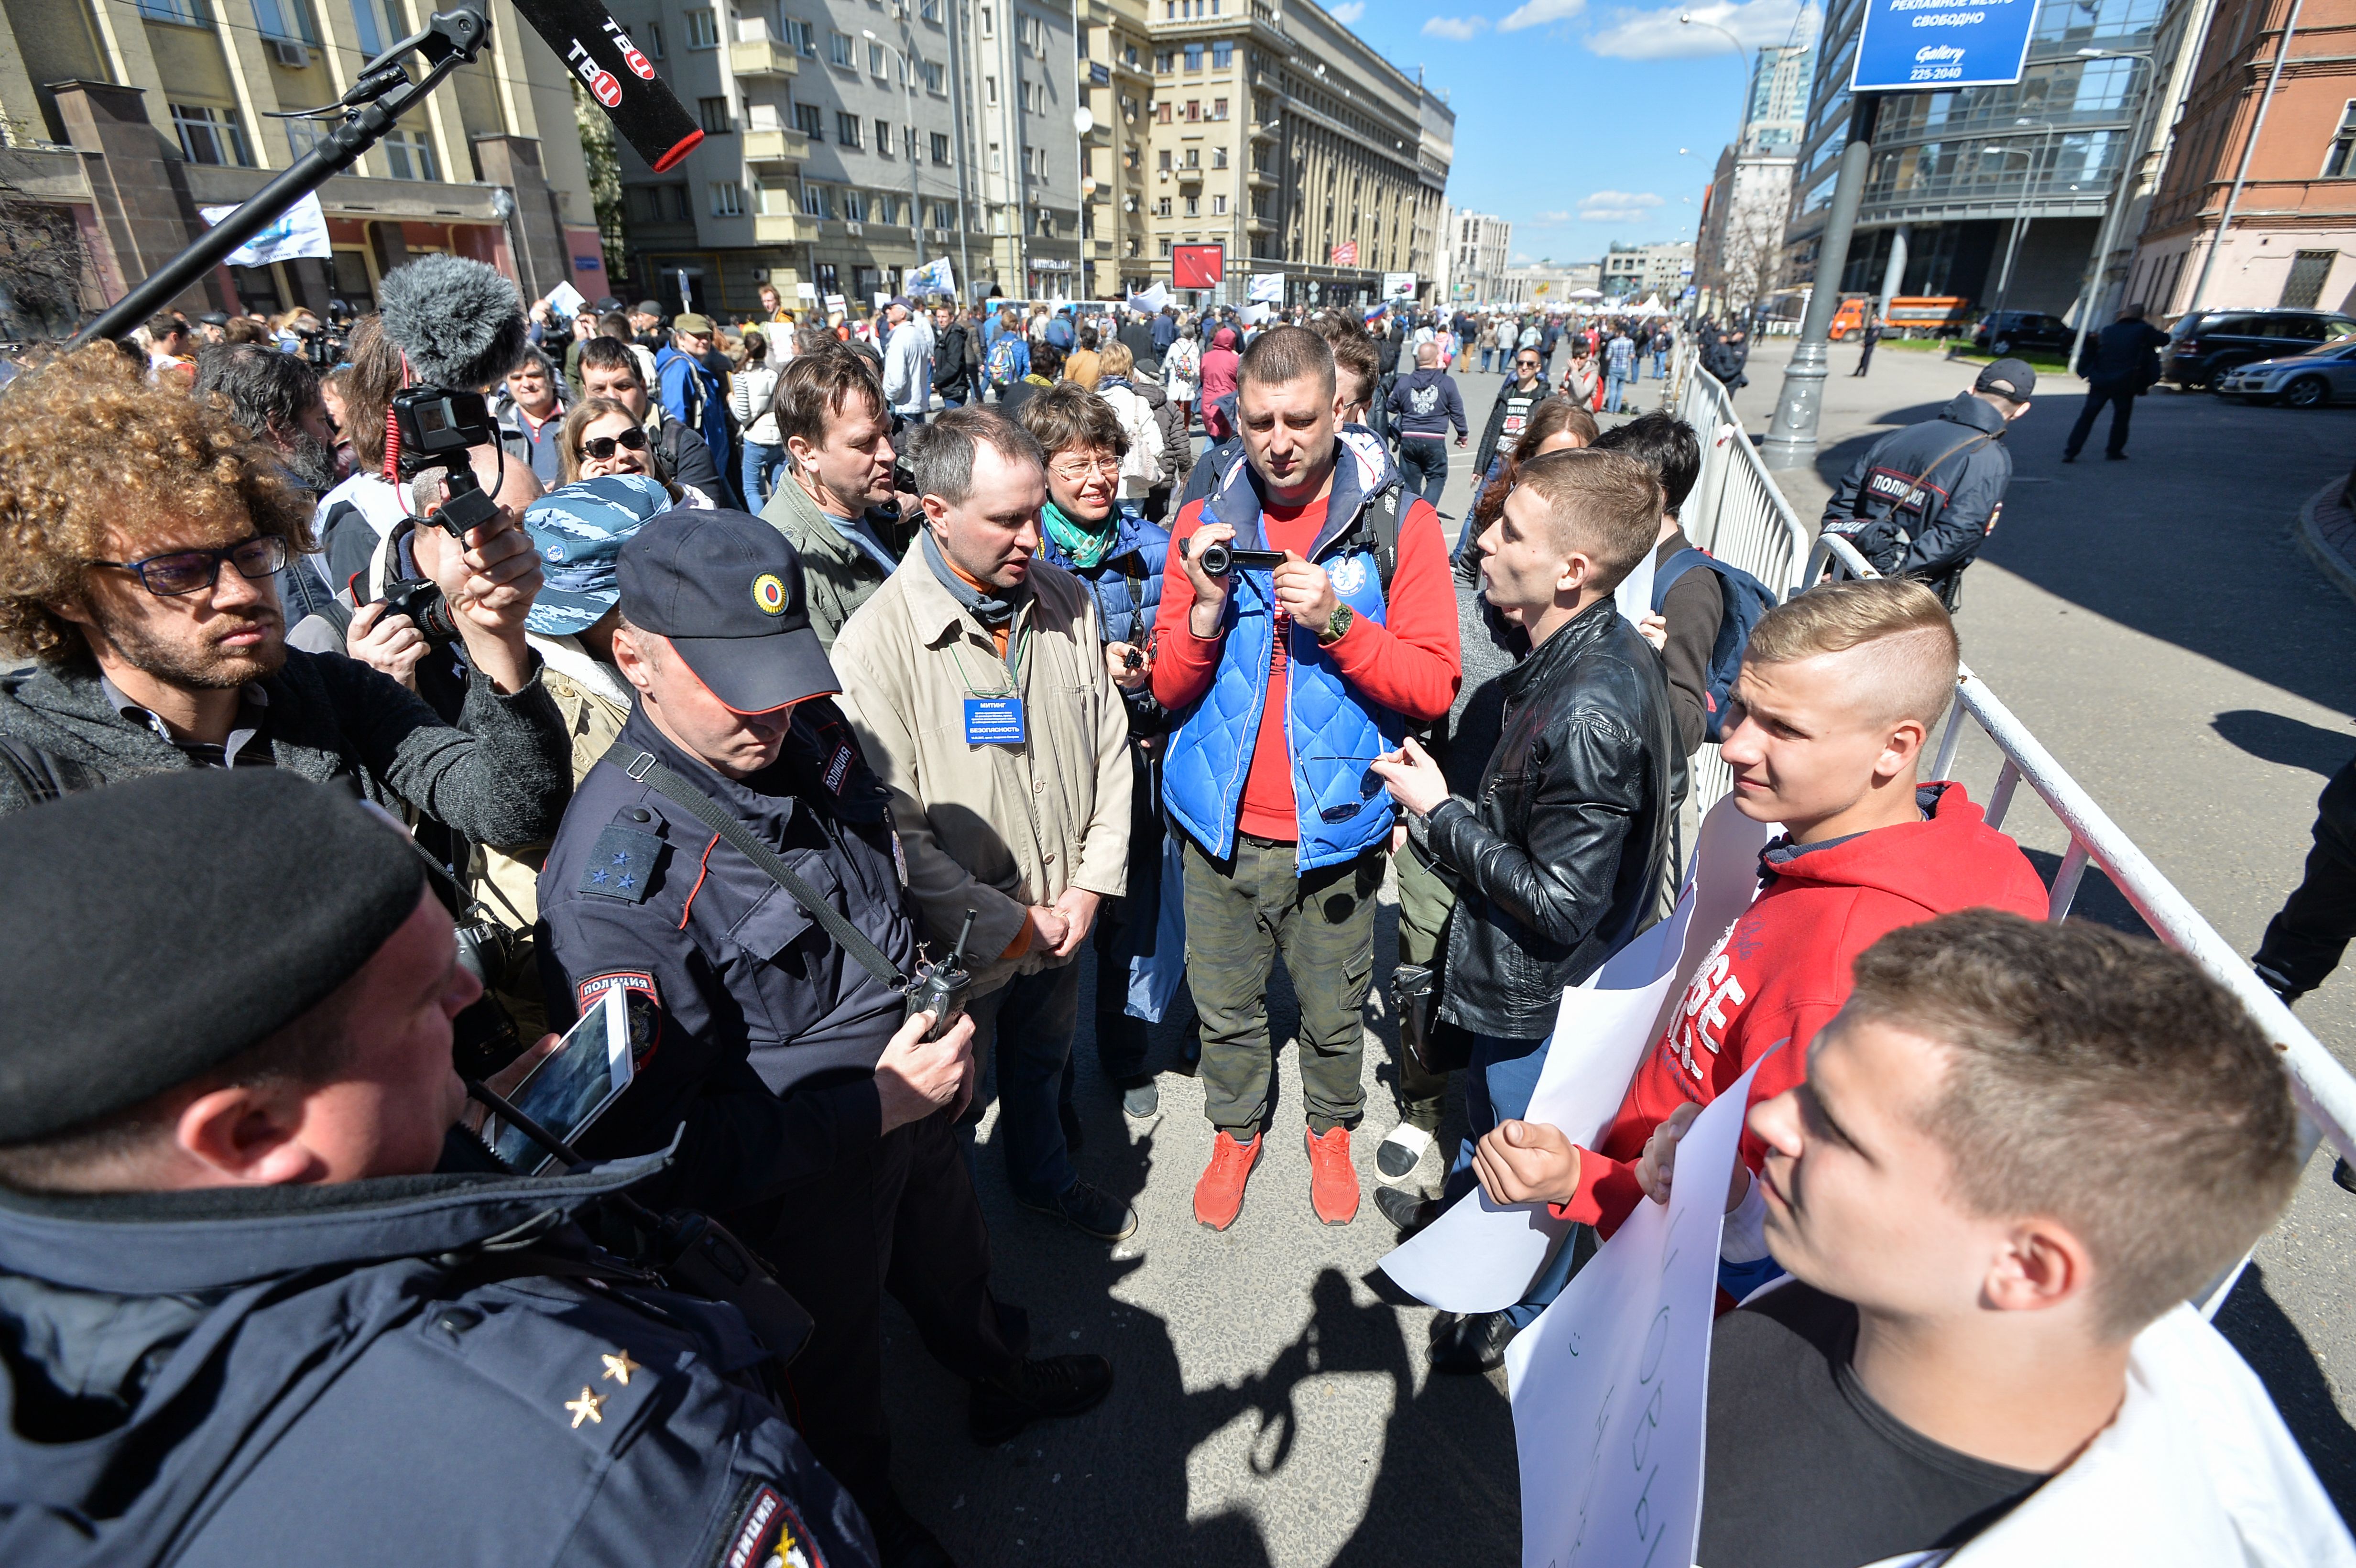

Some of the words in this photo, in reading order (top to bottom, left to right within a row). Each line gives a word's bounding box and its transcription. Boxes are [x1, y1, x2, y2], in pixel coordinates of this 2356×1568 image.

[1912, 12, 1985, 27] СВОБОДНО
[602, 16, 652, 77] ТВЦ
[1915, 44, 1966, 64] Gallery
[567, 38, 619, 105] ТВЦ
[1909, 67, 1963, 80] 225-2040
[416, 581, 434, 590] Canon
[826, 746, 851, 791] ПОЛИЦИЯ
[730, 1494, 777, 1568] ЛИЦИЯ
